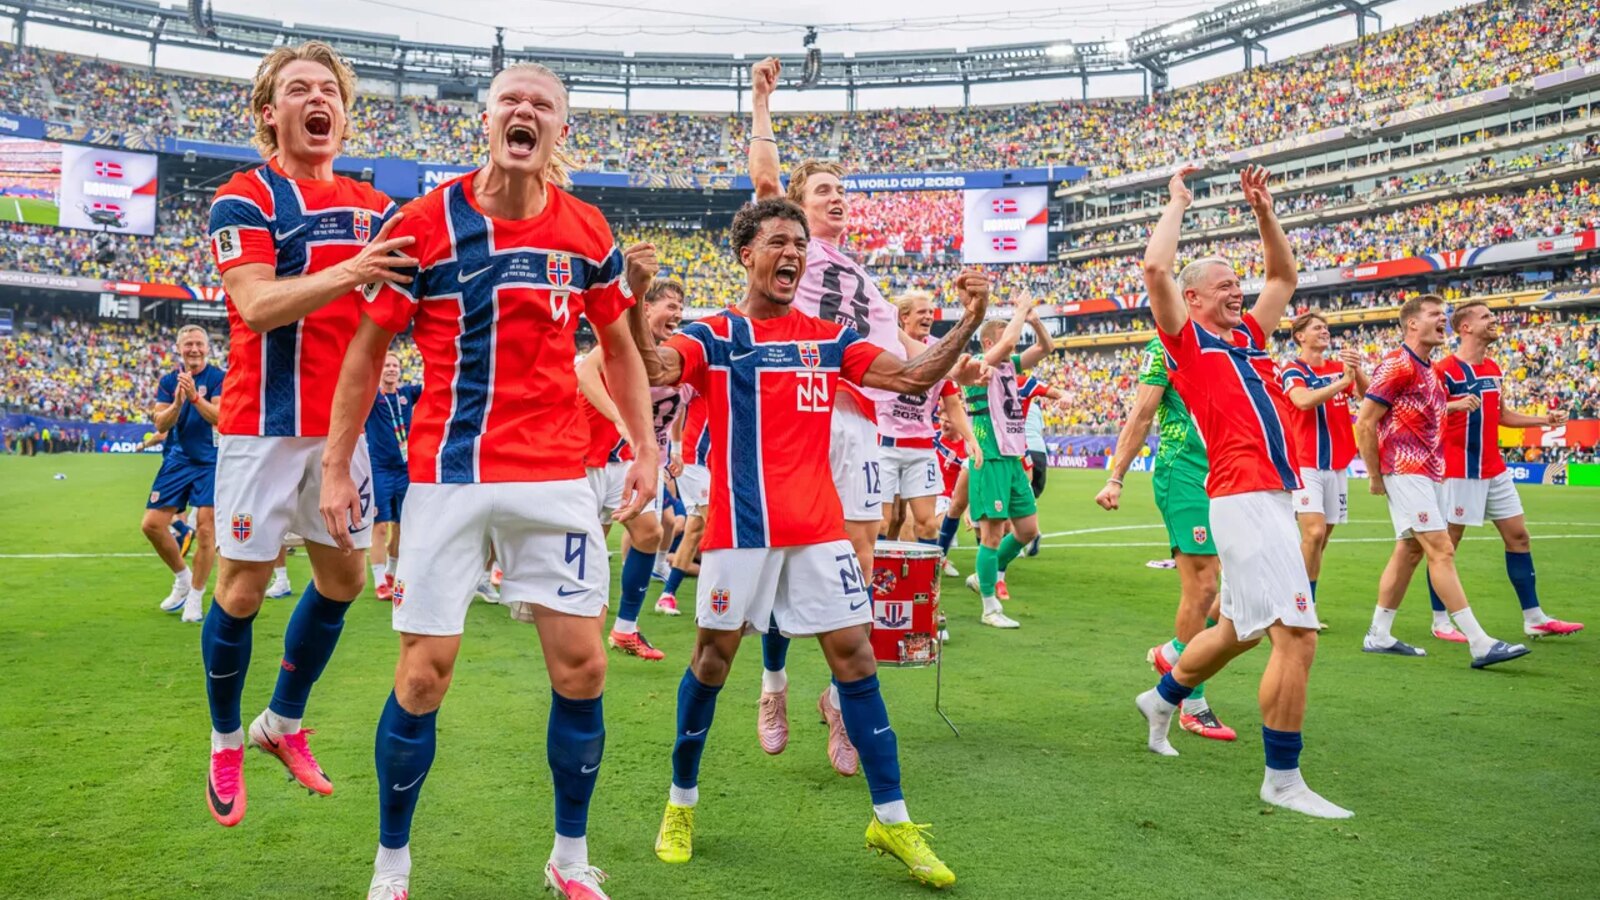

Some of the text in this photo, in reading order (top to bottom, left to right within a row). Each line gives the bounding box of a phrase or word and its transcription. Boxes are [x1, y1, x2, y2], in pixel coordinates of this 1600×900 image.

[859, 178, 899, 189] WORLD
[900, 178, 923, 188] CUP
[924, 176, 965, 187] 2026
[795, 371, 830, 412] 22
[892, 409, 925, 422] 2026
[1057, 455, 1087, 468] AIRWAYS
[565, 532, 587, 580] 9
